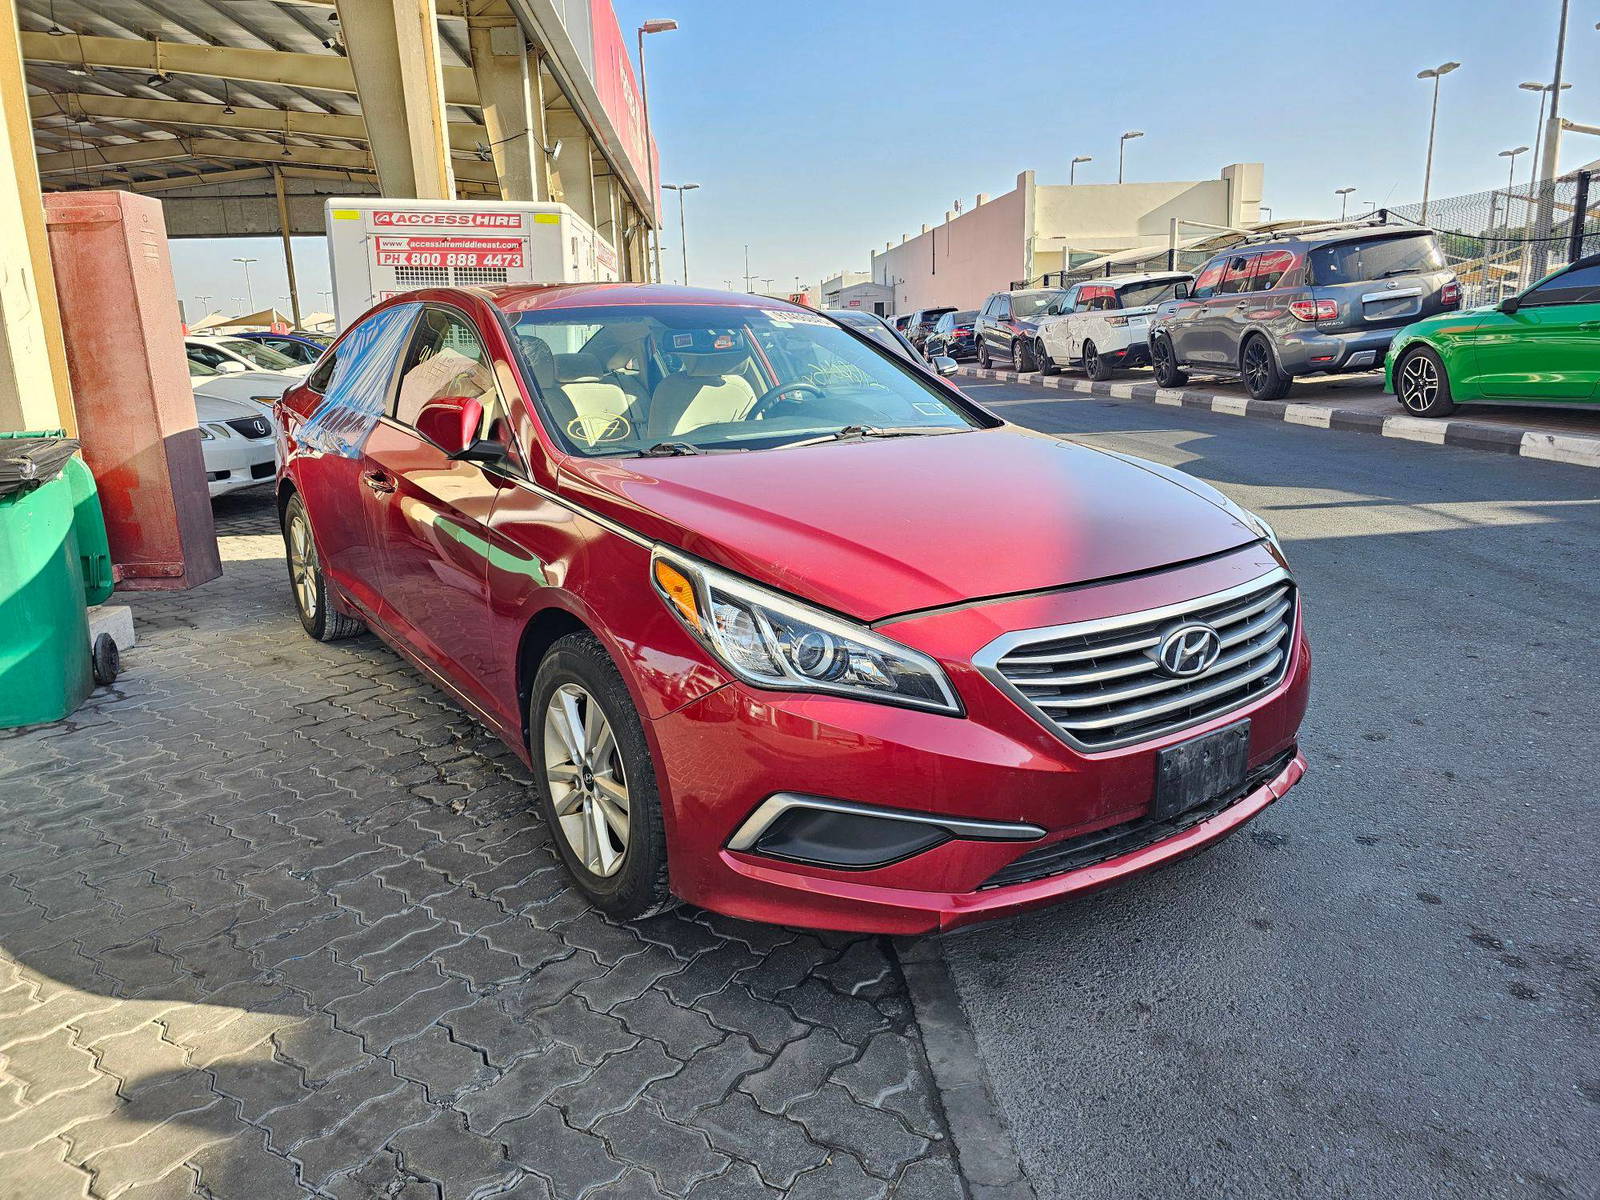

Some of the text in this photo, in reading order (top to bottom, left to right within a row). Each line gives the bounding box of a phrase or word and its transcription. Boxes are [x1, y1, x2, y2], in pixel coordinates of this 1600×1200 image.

[395, 214, 471, 225] ACCESS
[475, 215, 520, 226] HIRE
[383, 253, 521, 267] PH 800 888 4473
